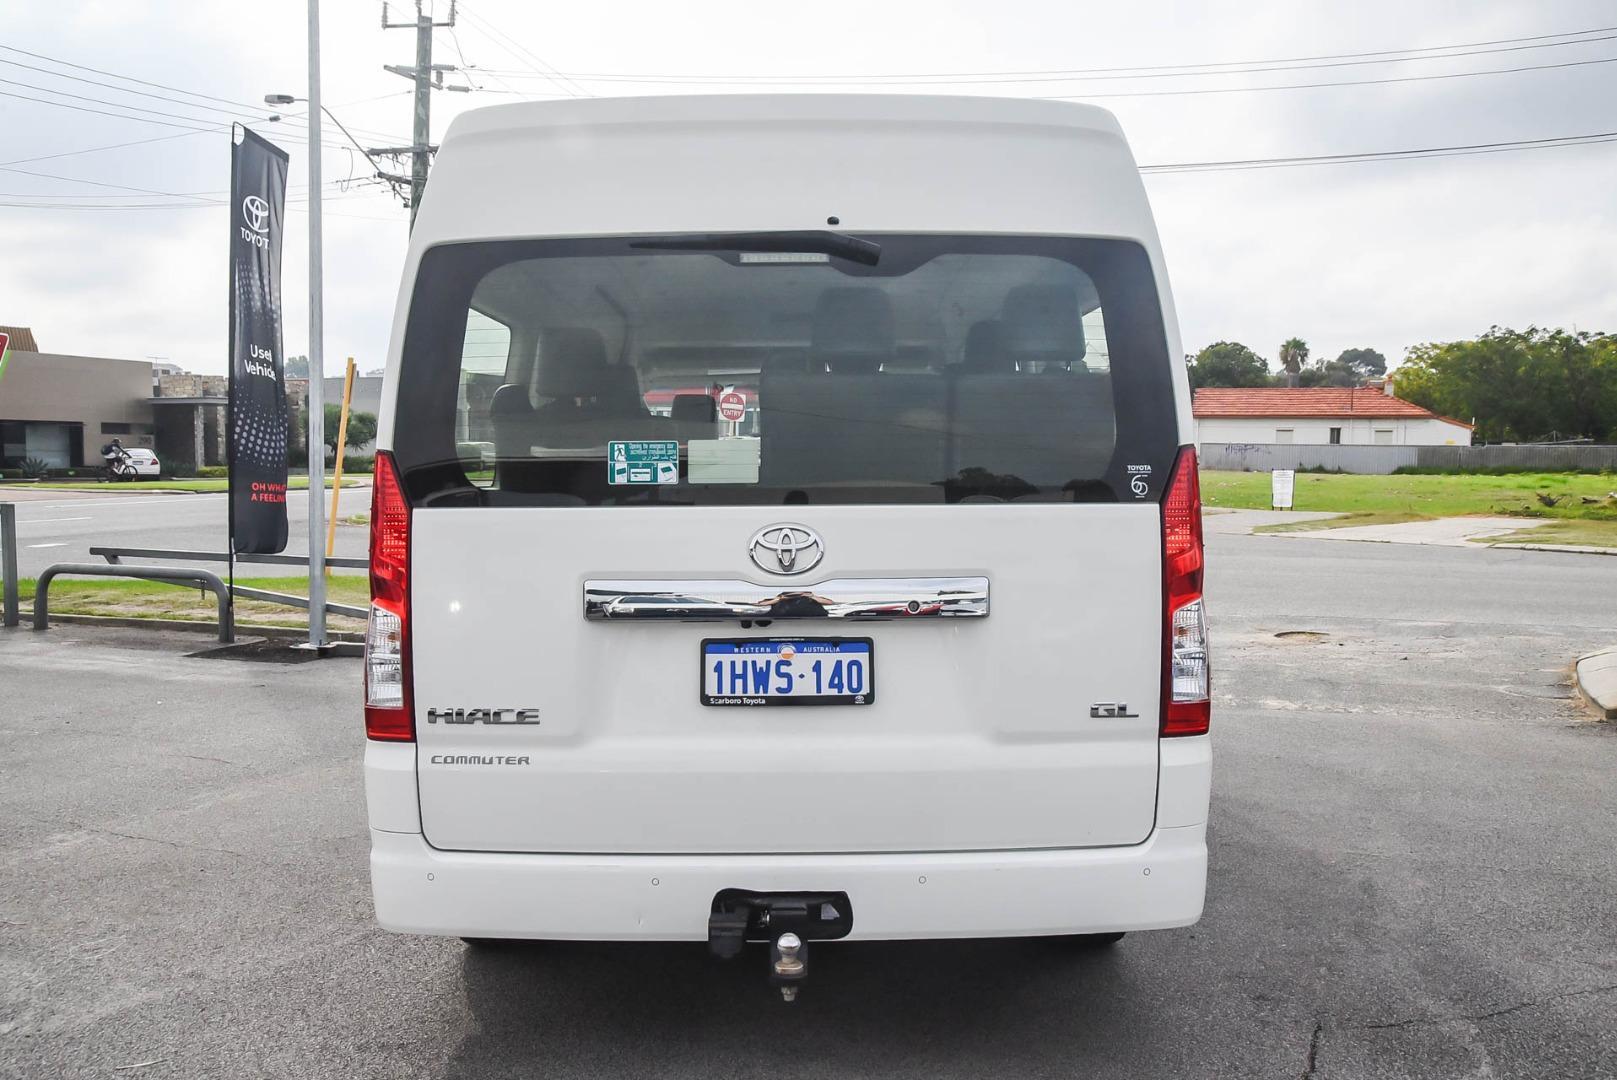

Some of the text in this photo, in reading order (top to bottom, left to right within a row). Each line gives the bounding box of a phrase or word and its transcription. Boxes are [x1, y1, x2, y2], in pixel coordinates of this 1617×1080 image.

[240, 226, 269, 249] TOYOT
[251, 482, 266, 491] OH
[251, 493, 257, 501] A
[743, 697, 766, 706] Toyota
[1090, 702, 1139, 718] GL
[427, 707, 541, 725] HIACE
[430, 755, 530, 765] COMMUTER
